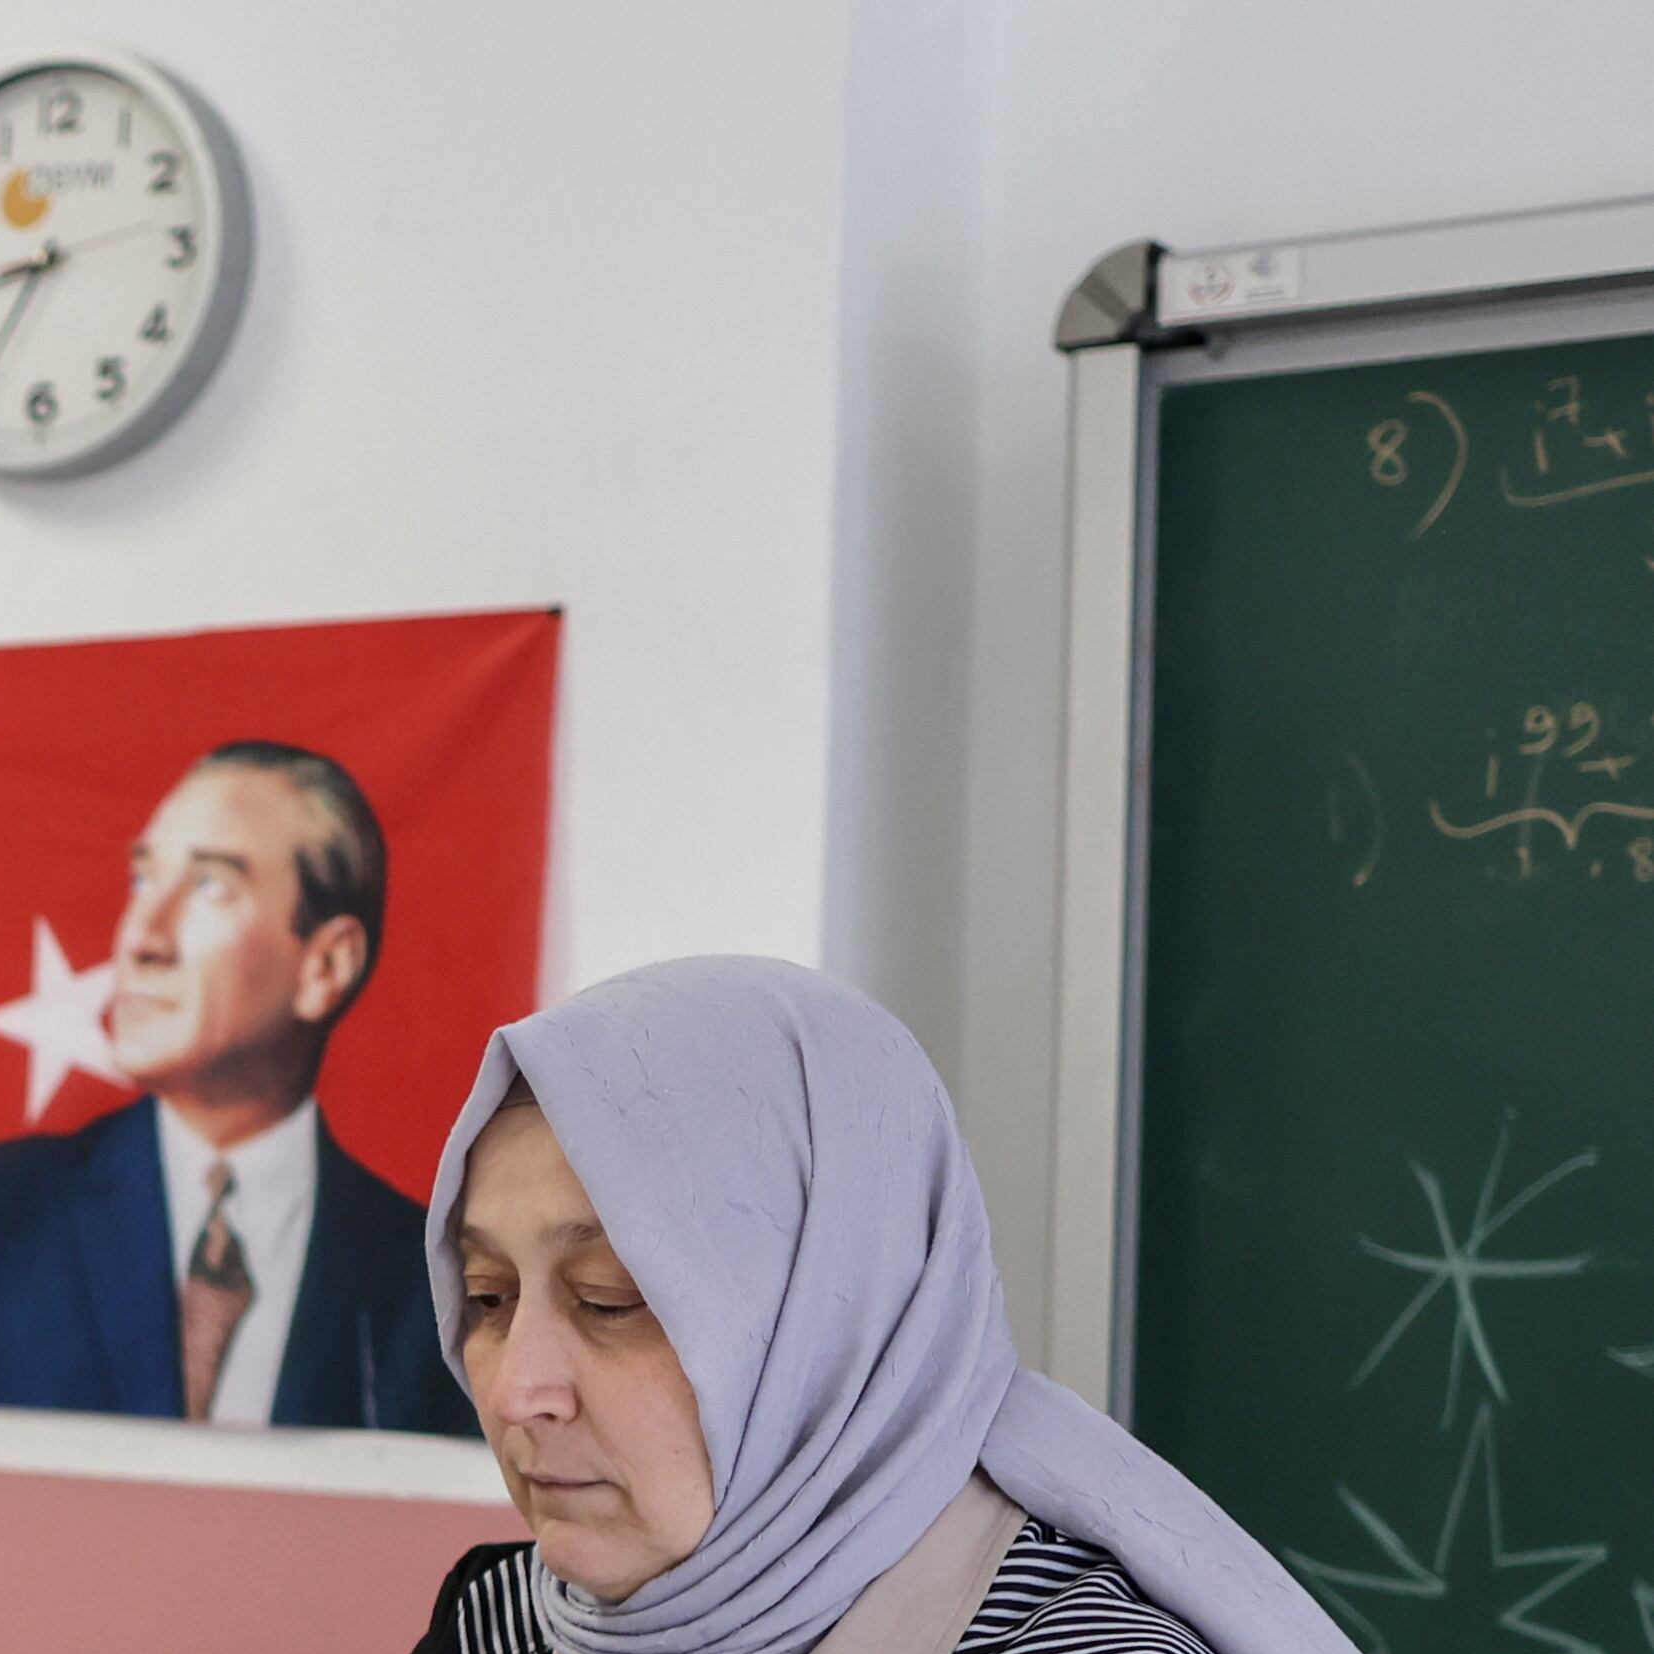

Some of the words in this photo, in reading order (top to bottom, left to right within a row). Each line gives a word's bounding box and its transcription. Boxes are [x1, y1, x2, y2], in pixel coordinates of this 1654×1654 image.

[38, 91, 83, 134] 12
[117, 106, 132, 147] 1
[147, 151, 178, 194] 2
[167, 224, 196, 269] 3
[141, 304, 172, 343] 4
[97, 356, 126, 401] 5
[26, 382, 59, 425] 6
